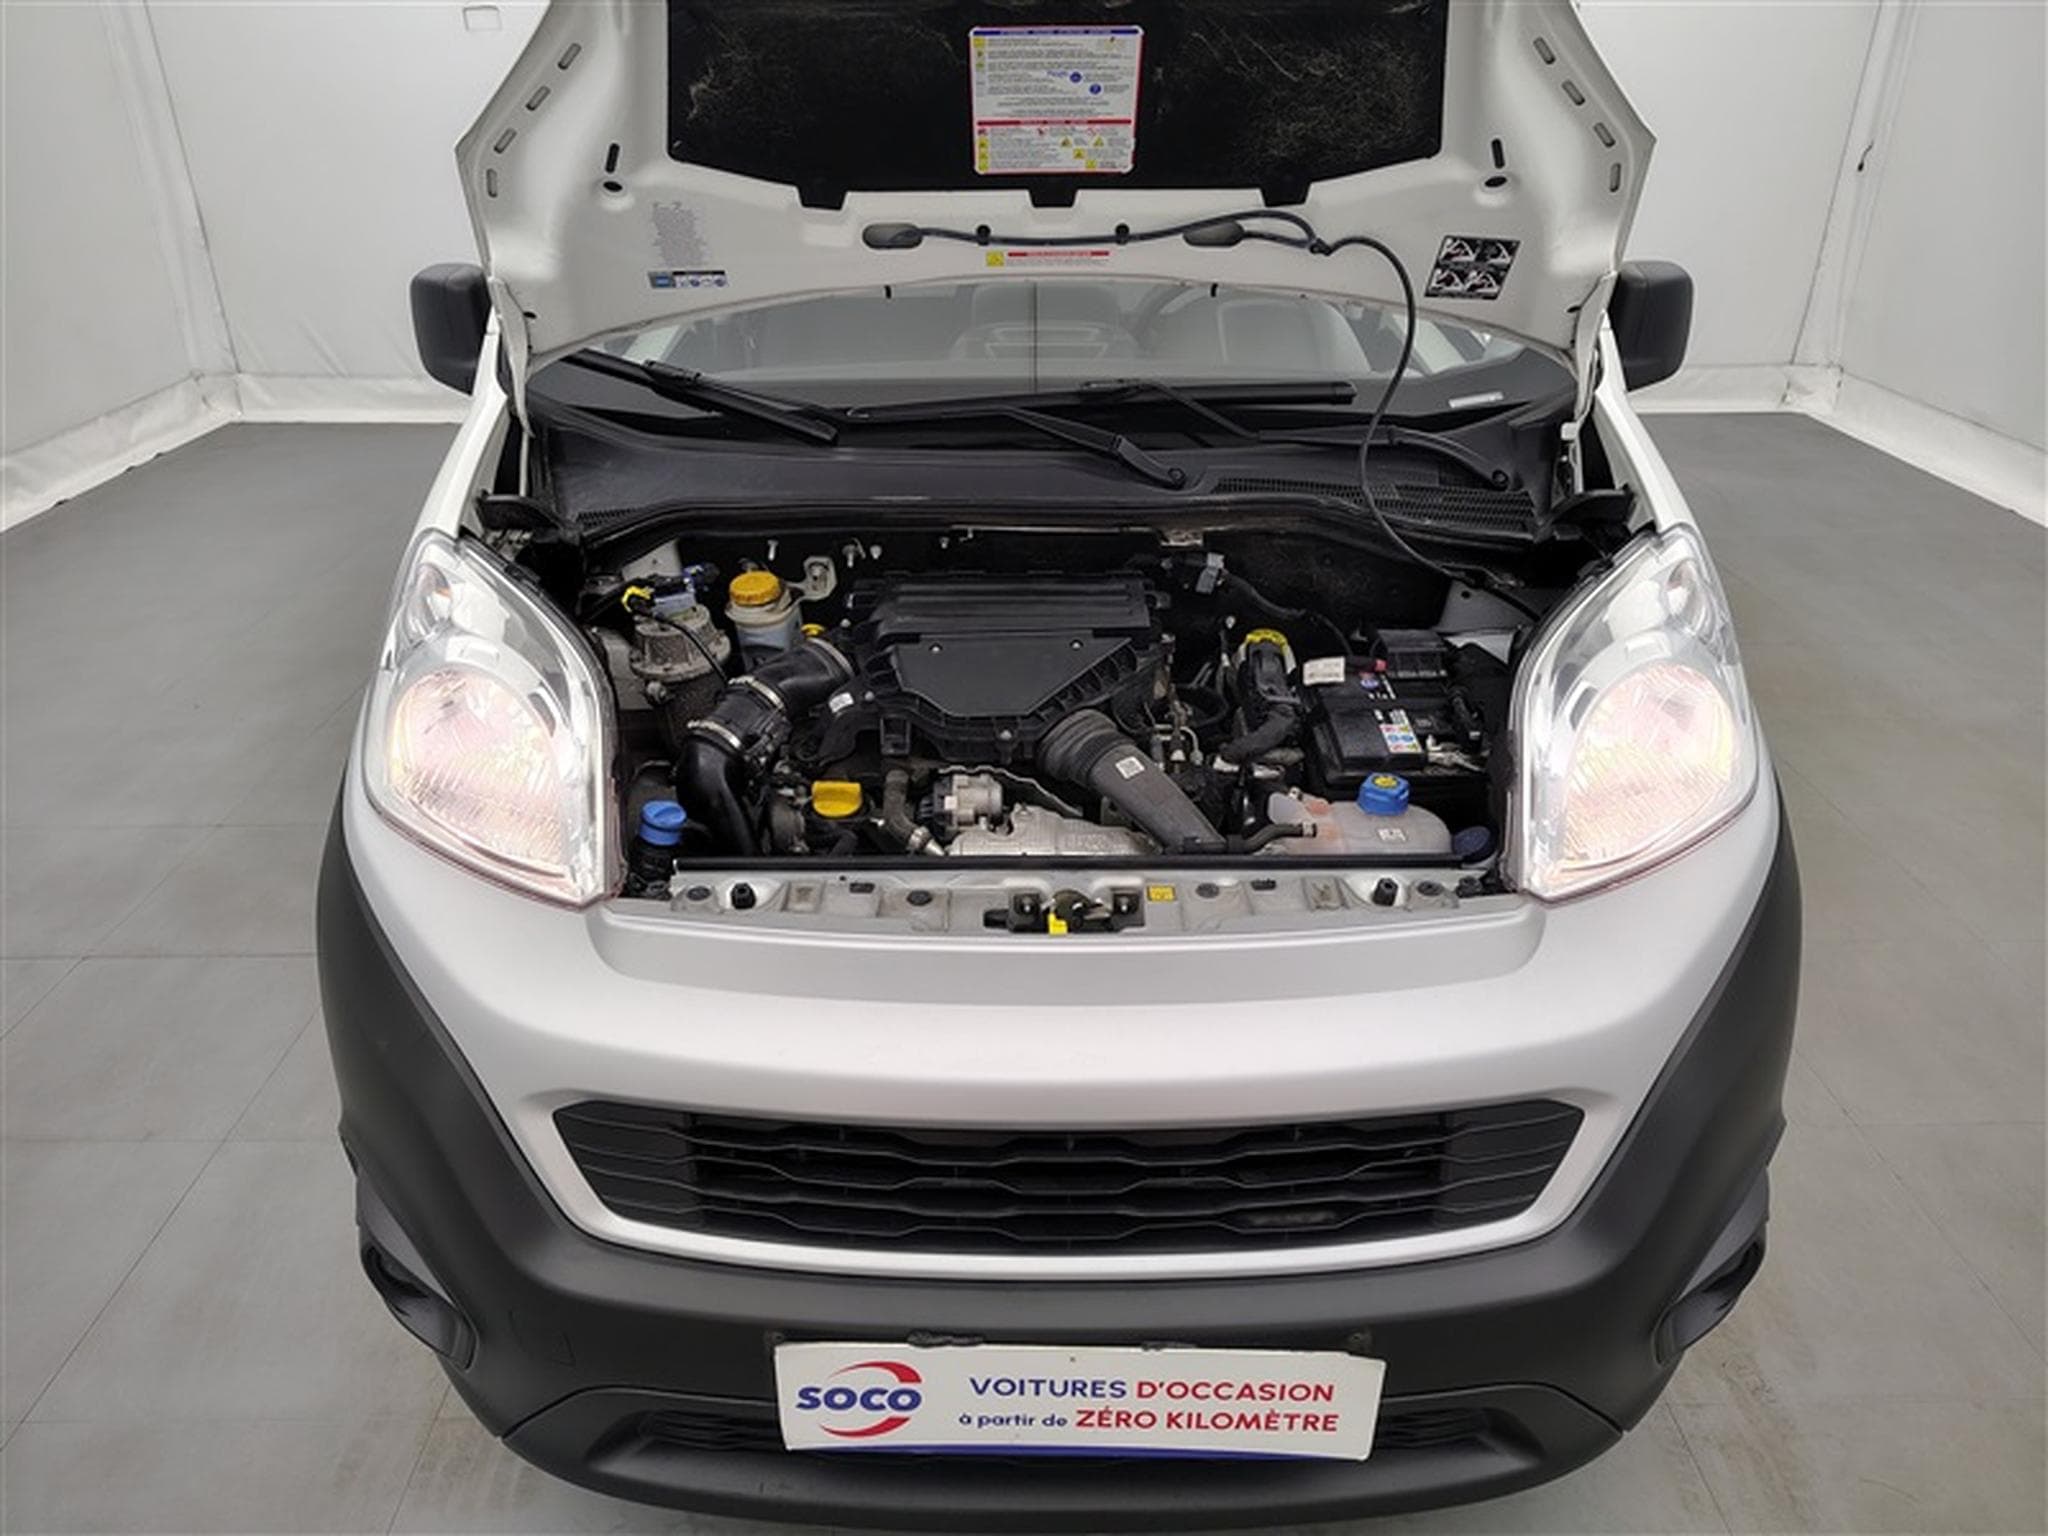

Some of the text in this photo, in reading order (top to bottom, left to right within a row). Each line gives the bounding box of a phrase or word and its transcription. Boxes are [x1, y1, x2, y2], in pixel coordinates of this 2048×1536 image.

[796, 1386, 922, 1411] SOCO
[969, 1377, 1335, 1401] VOITURES D'OCCASION
[958, 1405, 1340, 1432] à partir de ZÉRO KILOMÈTRE
